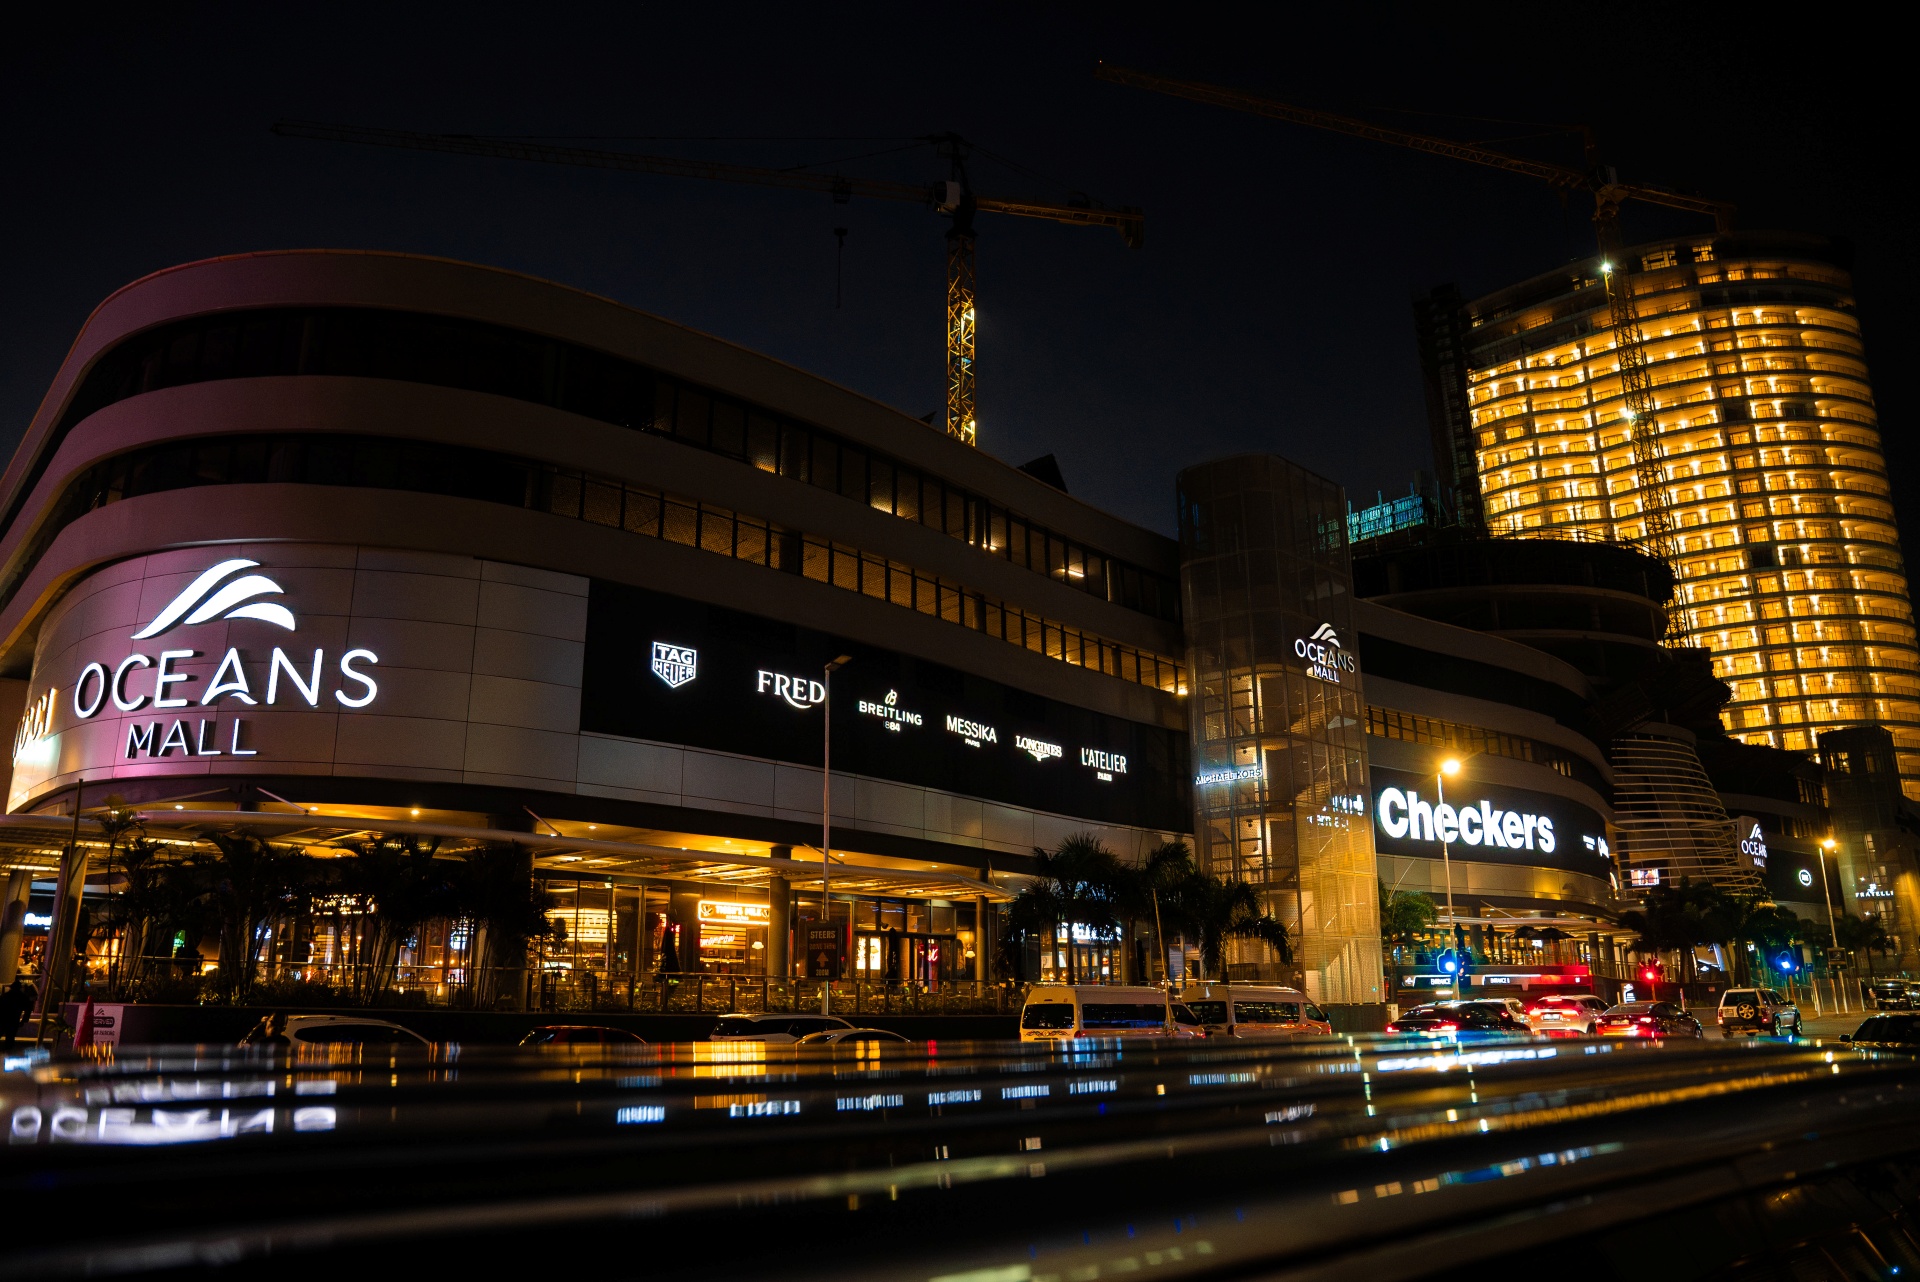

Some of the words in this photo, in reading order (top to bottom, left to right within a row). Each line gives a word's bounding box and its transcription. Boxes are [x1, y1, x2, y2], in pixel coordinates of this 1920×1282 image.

[656, 645, 693, 665] TAG
[1295, 639, 1355, 673] OCEANS
[74, 647, 379, 718] OCEANS
[655, 660, 694, 685] HEUER
[1313, 664, 1340, 683] MALL
[757, 670, 826, 709] FRED
[859, 701, 922, 726] BREITLING
[125, 718, 257, 759] MALL
[946, 715, 997, 743] MESSIKA
[965, 738, 980, 748] PARIS
[1015, 735, 1062, 758] LONGINES
[1081, 747, 1127, 774] L'ATELIER
[1195, 771, 1234, 785] MICHAEL
[1237, 768, 1263, 780] KORS
[1379, 787, 1556, 853] Checkers
[1855, 890, 1895, 898] FRATELLI
[810, 930, 836, 940] STEERS
